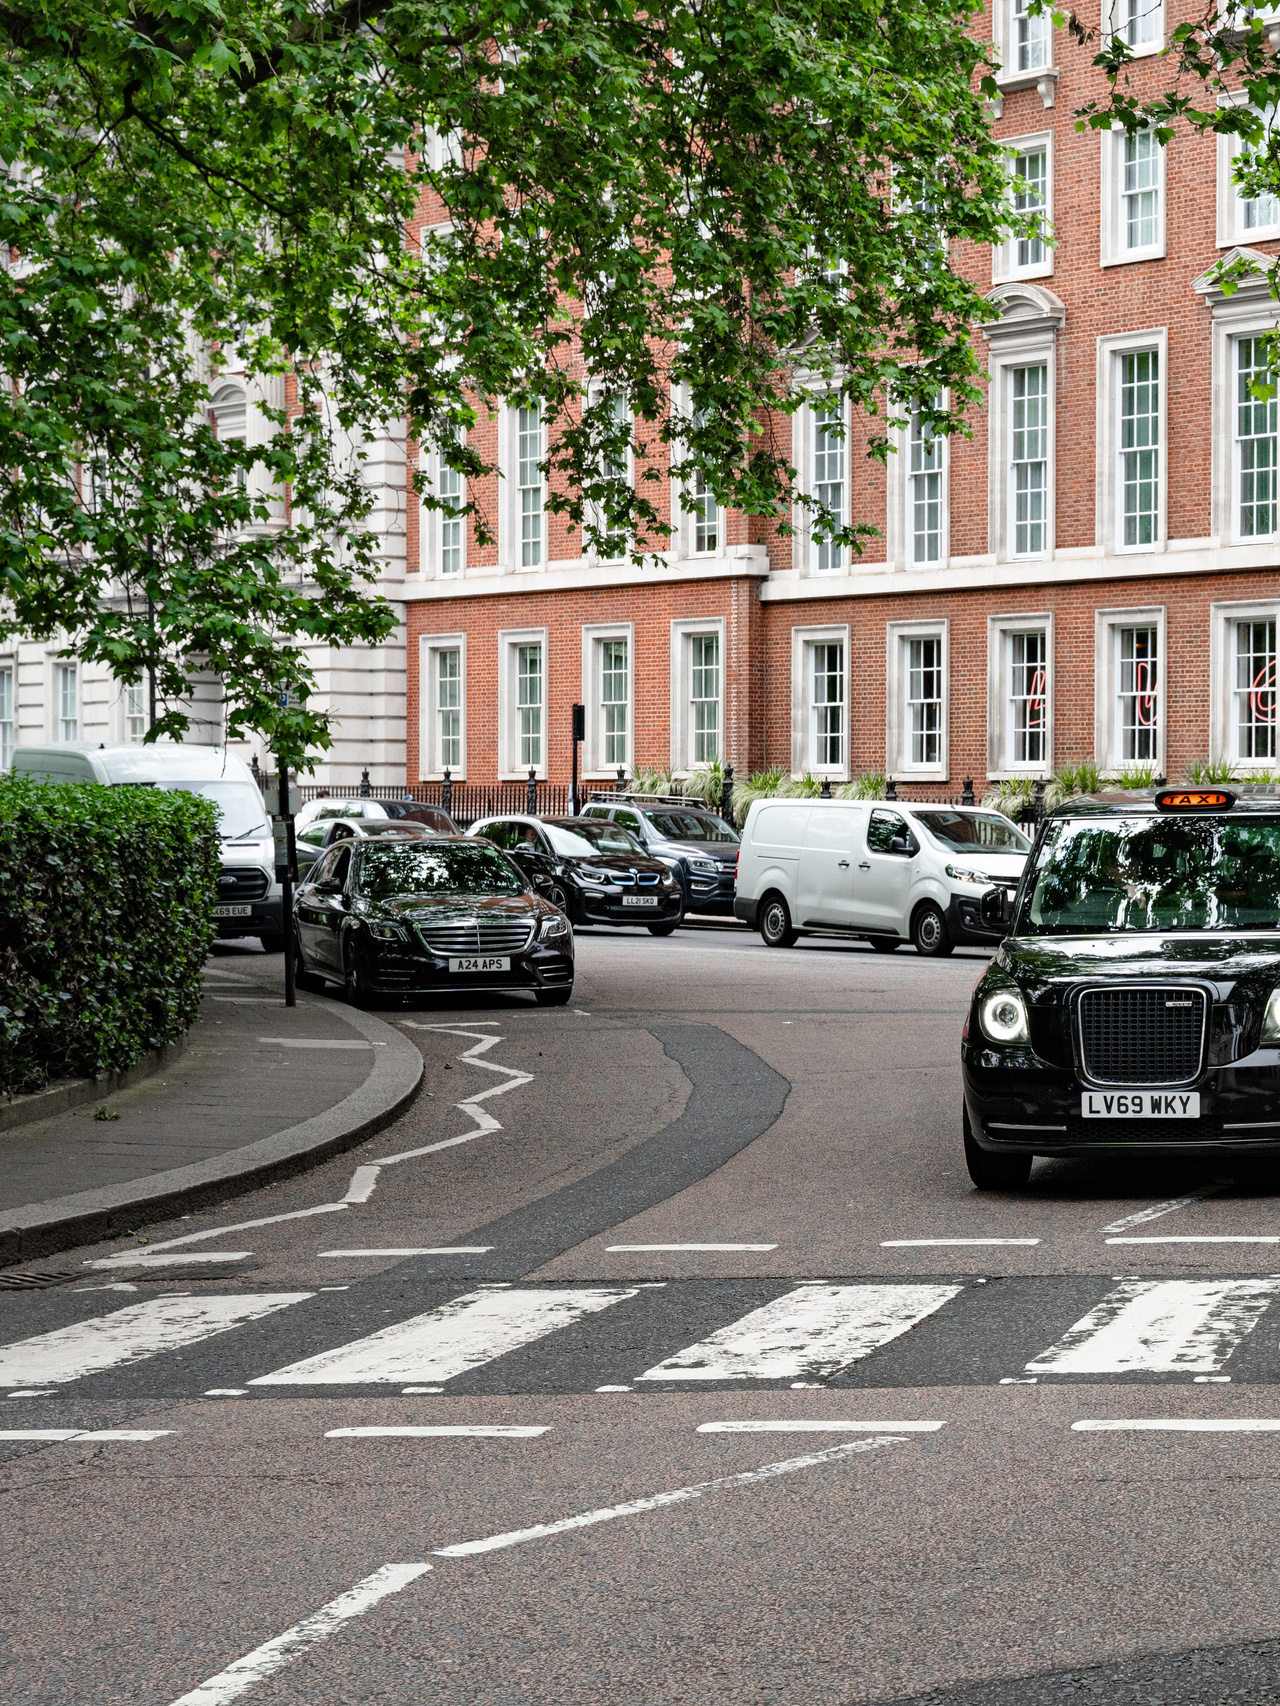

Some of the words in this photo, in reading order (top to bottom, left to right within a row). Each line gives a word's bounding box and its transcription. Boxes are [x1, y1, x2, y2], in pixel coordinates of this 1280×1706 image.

[1168, 795, 1221, 804] TAXI
[642, 897, 655, 905] SKD
[232, 906, 248, 915] EUE
[457, 959, 479, 970] A24
[481, 959, 503, 969] APS
[1088, 1095, 1144, 1114] LV69
[1150, 1095, 1191, 1114] WKY
